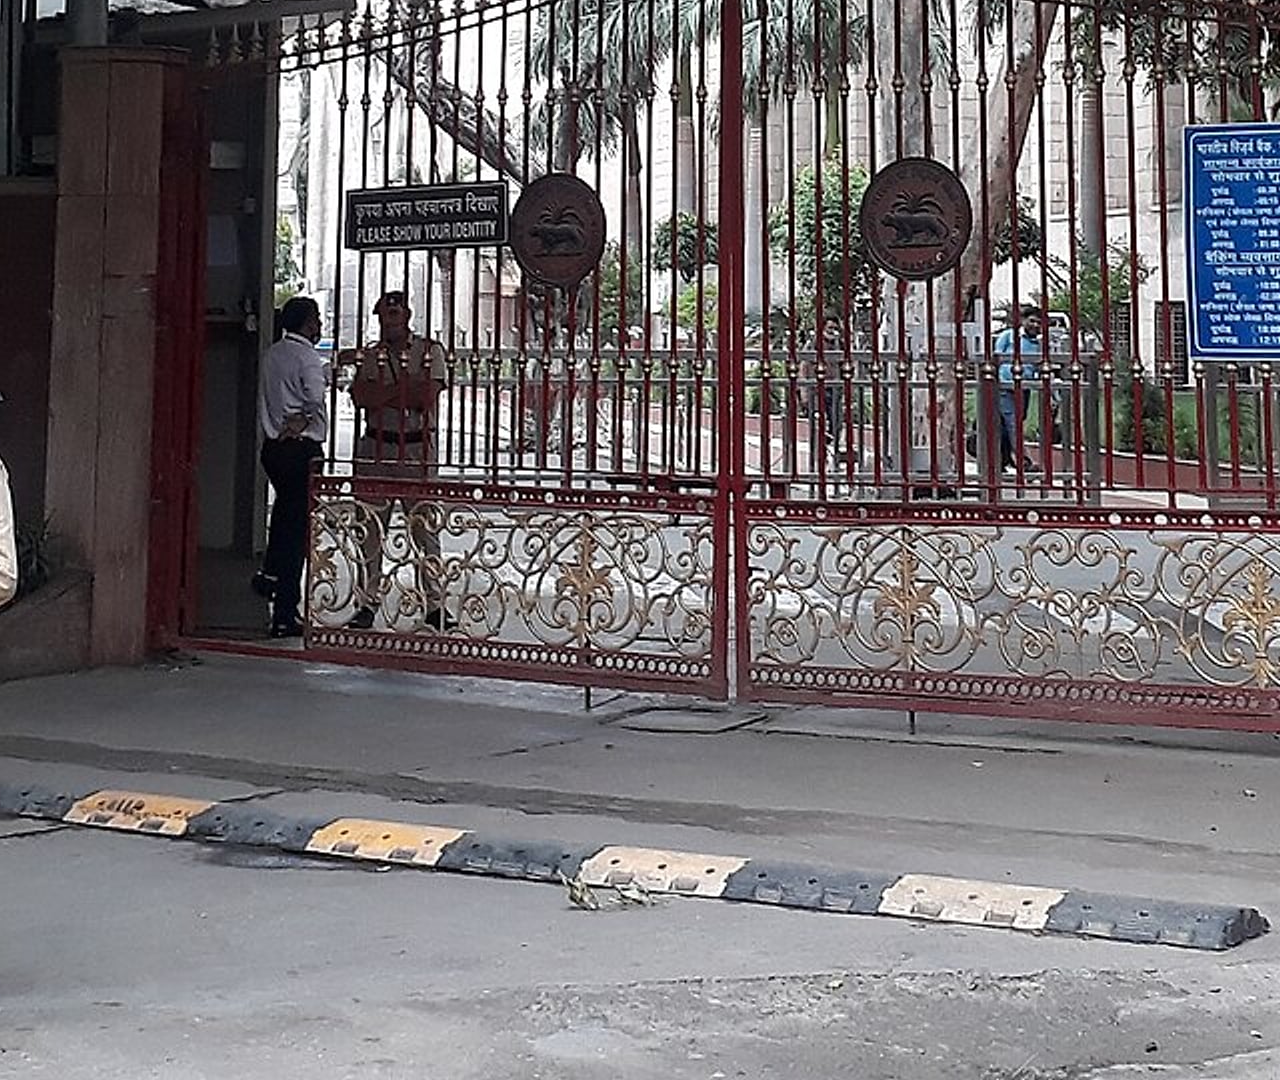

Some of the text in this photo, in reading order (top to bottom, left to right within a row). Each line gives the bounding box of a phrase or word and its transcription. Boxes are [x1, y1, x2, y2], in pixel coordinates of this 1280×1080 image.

[385, 202, 412, 217] अपना
[356, 221, 497, 243] PLEASE SHOW YOUR IDENTITY
